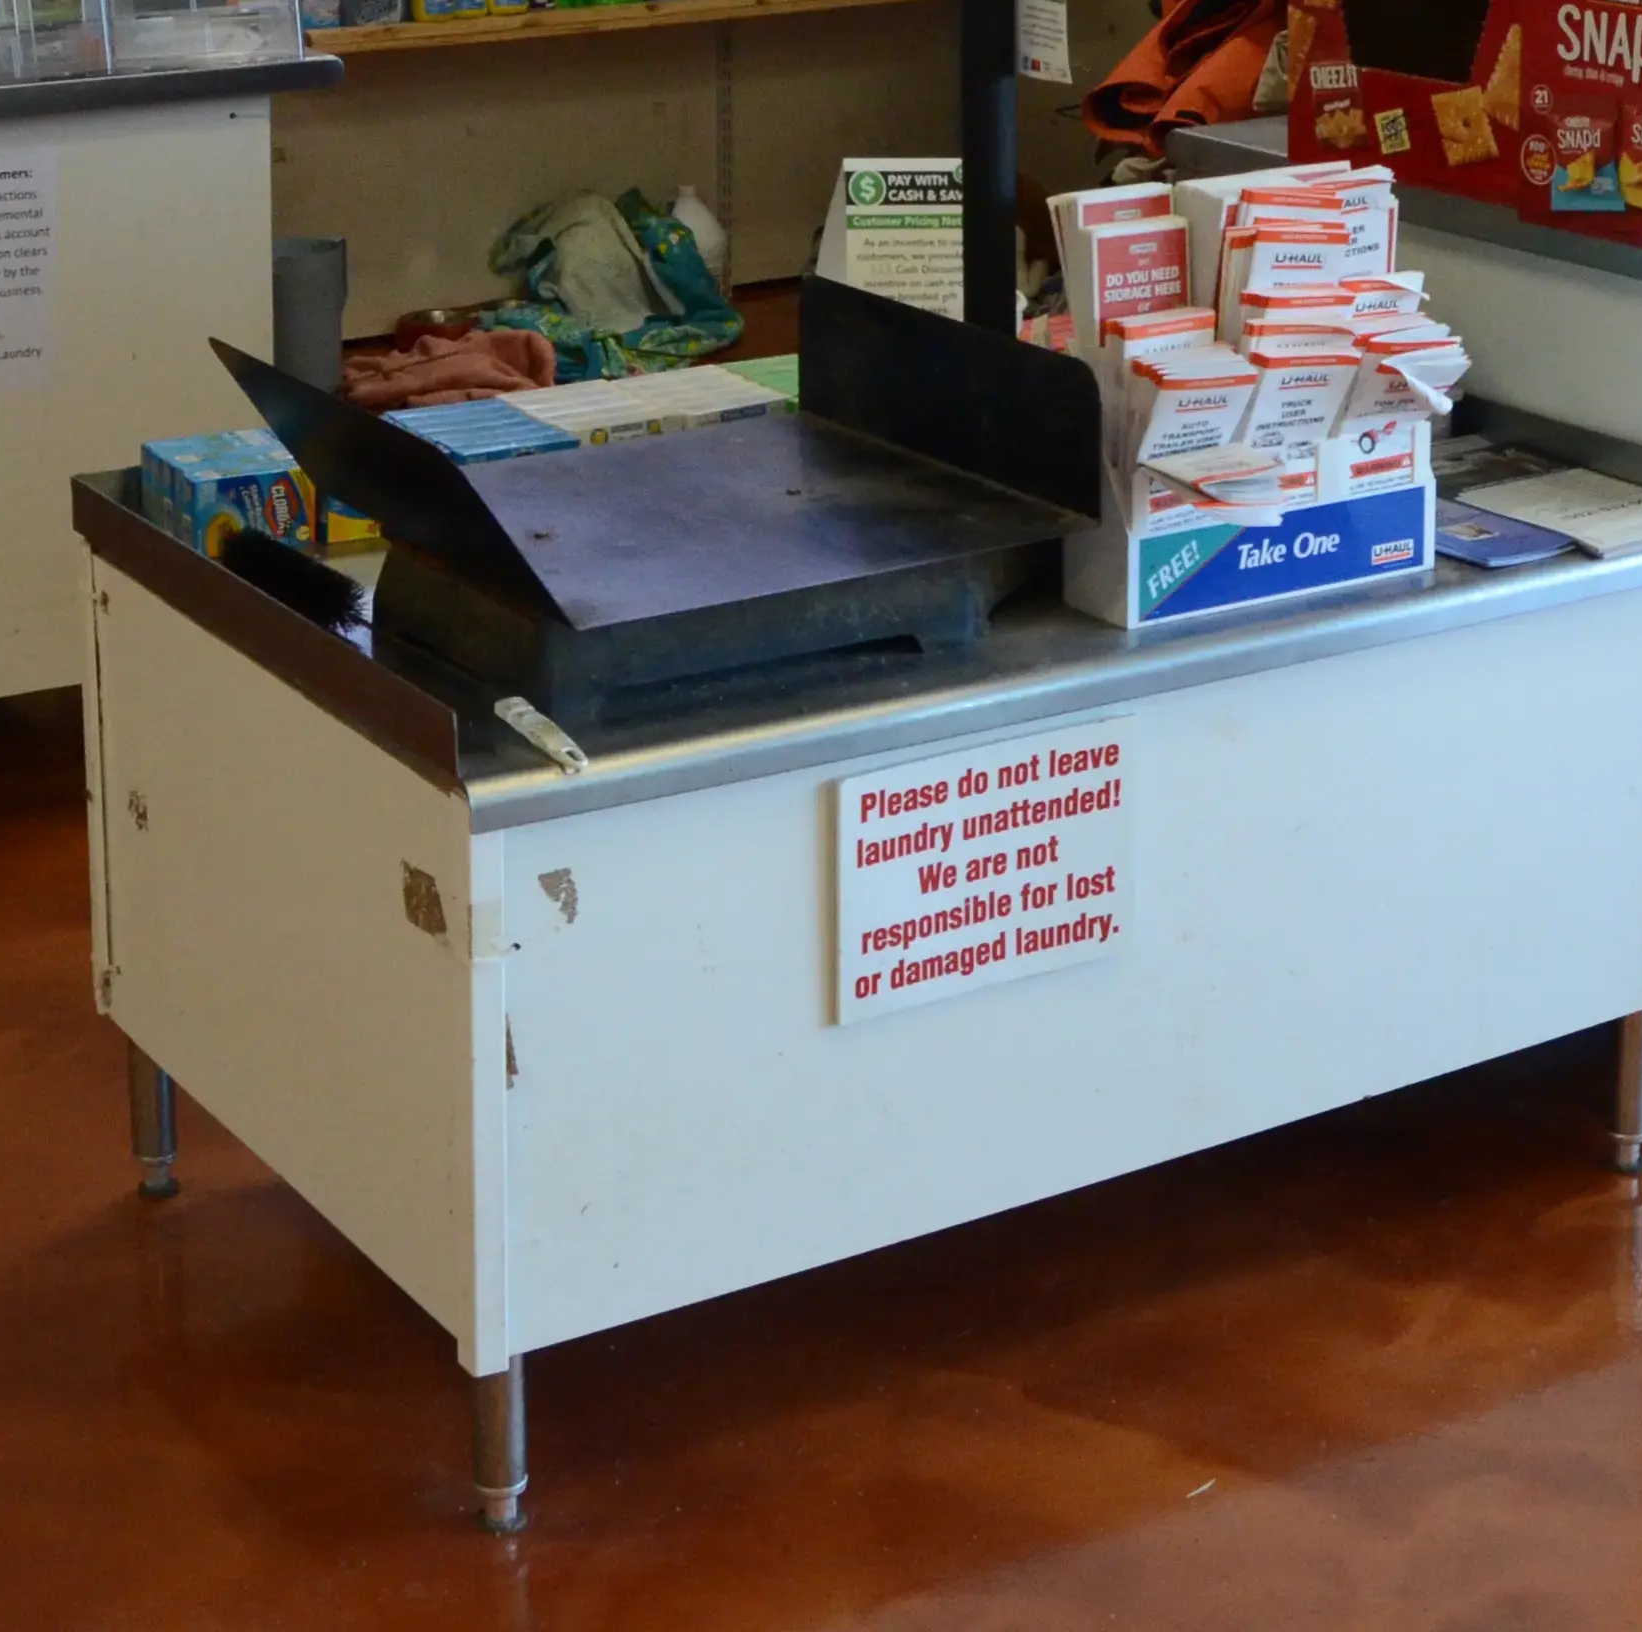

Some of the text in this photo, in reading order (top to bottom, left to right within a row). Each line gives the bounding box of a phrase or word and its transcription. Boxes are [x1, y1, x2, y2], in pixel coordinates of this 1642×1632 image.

[887, 175, 948, 186] PAY WITH
[888, 191, 937, 201] CASH &
[1104, 281, 1182, 303] STORAGE HERE
[1106, 267, 1179, 287] DO YOU NEED
[1281, 399, 1312, 408] TRUCK
[1147, 539, 1201, 599] FREE!
[1238, 532, 1340, 571] Take One
[860, 743, 1119, 823] Please do not leave
[857, 778, 1122, 868] laundry unattended!
[918, 835, 1059, 894] We are not
[862, 866, 1115, 955] responsible for lost
[855, 913, 1119, 999] or damaged laundry.
